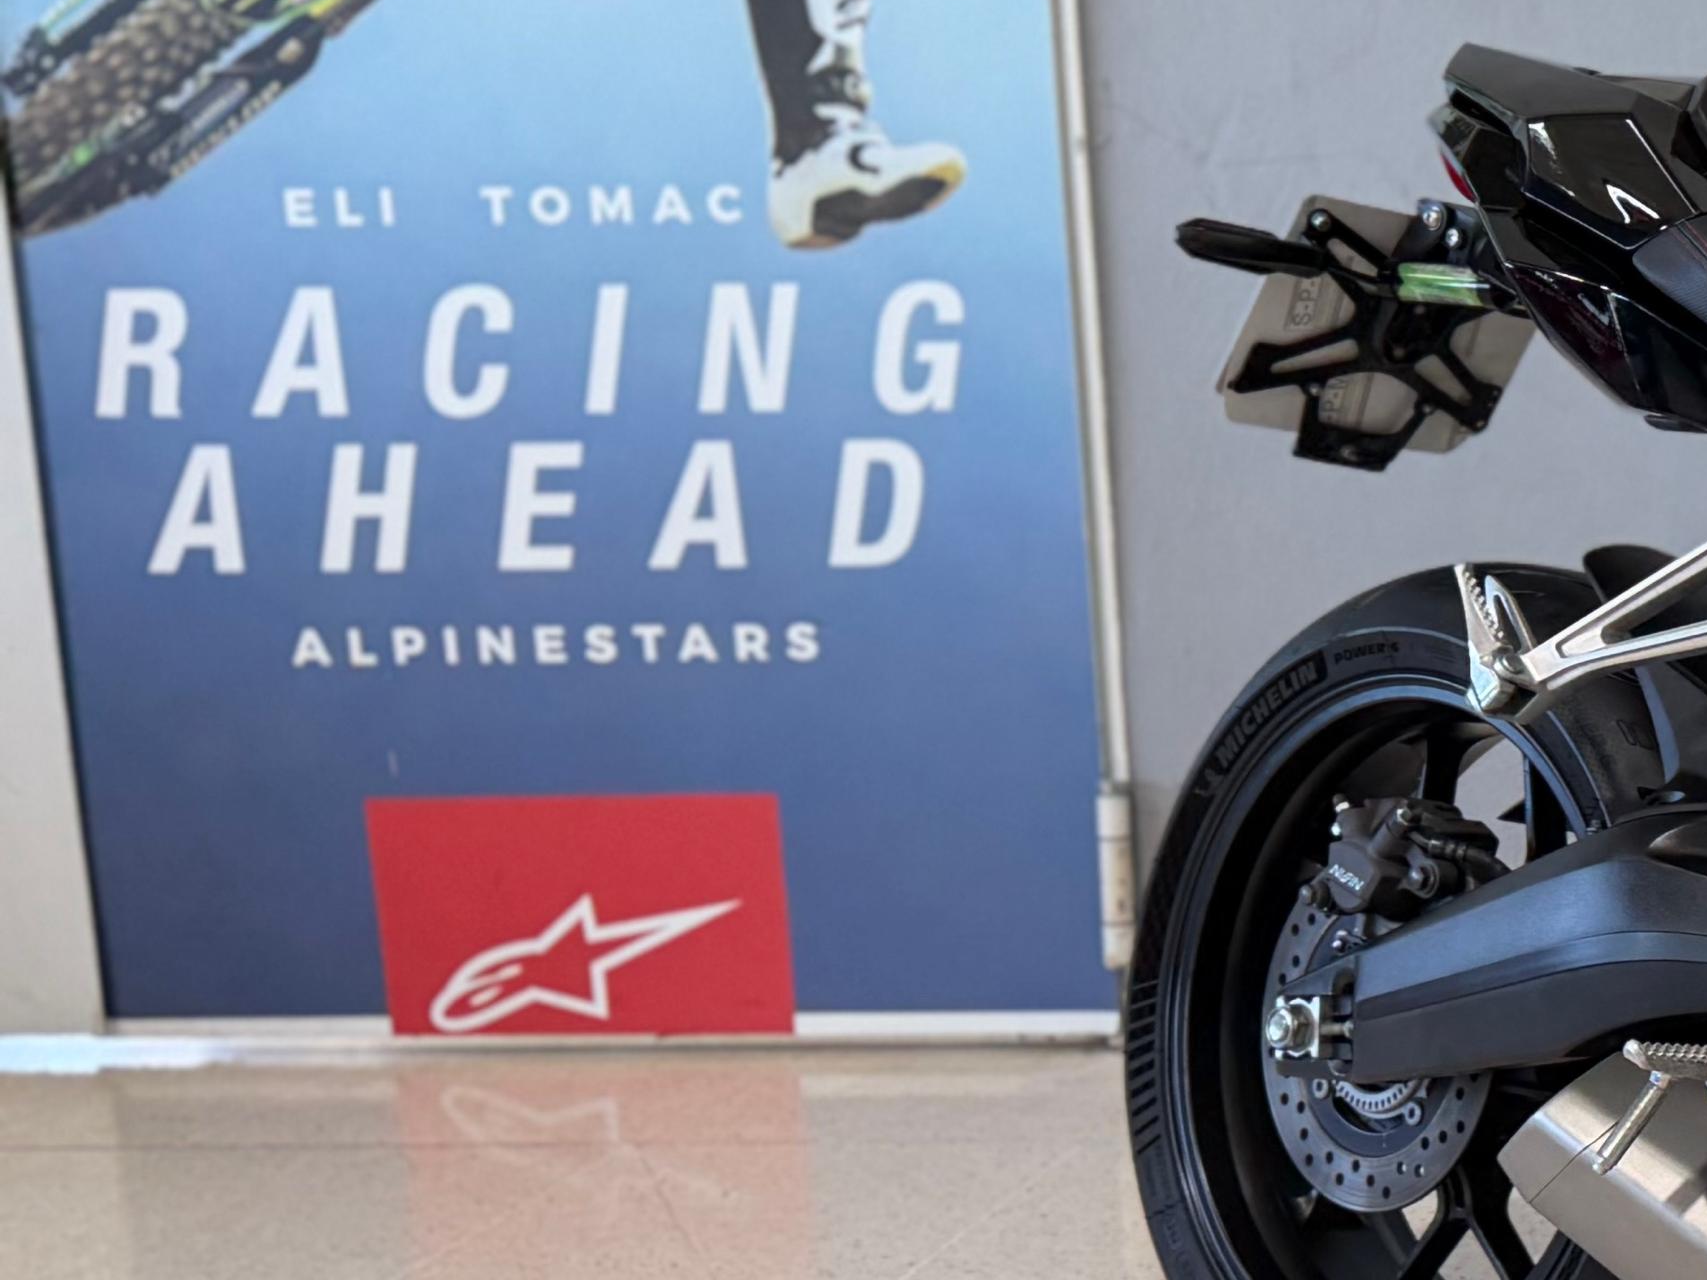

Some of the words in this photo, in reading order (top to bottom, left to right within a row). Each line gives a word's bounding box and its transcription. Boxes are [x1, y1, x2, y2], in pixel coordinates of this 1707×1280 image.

[281, 186, 395, 227] ELI
[478, 184, 744, 226] TOMAC
[95, 280, 966, 419] RACING
[147, 438, 926, 576] AHEAD
[291, 621, 822, 668] ALPINESTARS
[1214, 660, 1319, 770] MICHELIN
[1334, 642, 1386, 665] POWER
